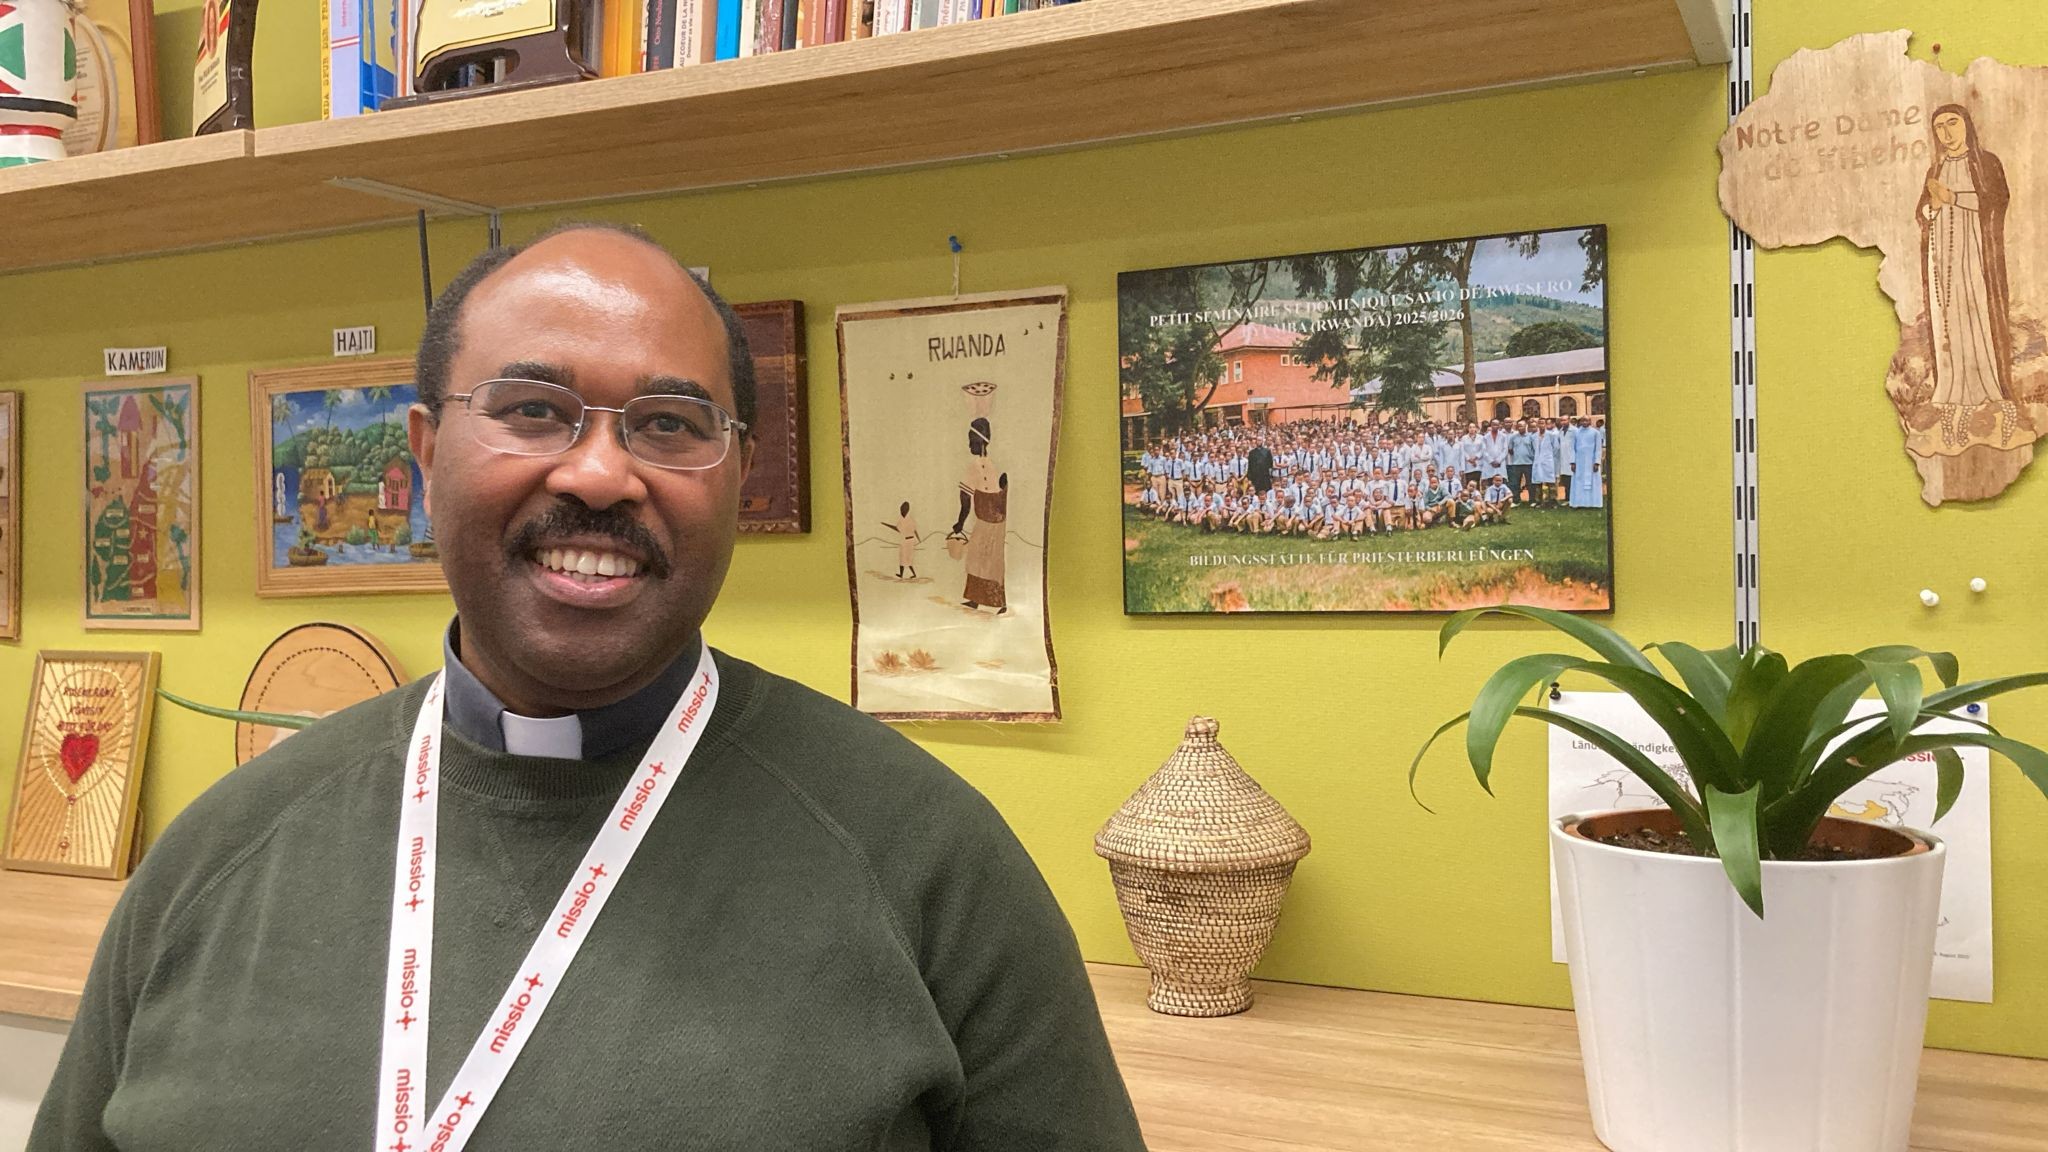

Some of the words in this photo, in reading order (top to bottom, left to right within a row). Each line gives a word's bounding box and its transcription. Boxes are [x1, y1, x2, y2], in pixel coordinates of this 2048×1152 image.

[681, 20, 688, 29] DE
[682, 8, 688, 18] LA
[679, 30, 687, 56] COEUR
[1736, 120, 1820, 151] Notre
[1836, 103, 1921, 135] Dame
[1150, 311, 1192, 327] PETIT
[1307, 294, 1401, 313] DOMINIQUE
[1405, 290, 1455, 304] SAVIO
[1460, 287, 1482, 301] DE
[1486, 279, 1573, 299] RWESERO
[1311, 314, 1392, 334] (RWANDA)
[1395, 308, 1465, 326] 2025/2026
[107, 349, 165, 371] KAMERUN
[337, 327, 374, 353] HAITI
[928, 332, 1006, 363] RWANDA
[1319, 551, 1348, 564] FÜR
[677, 686, 709, 733] missio
[416, 735, 432, 785] missio
[618, 776, 657, 831] missio
[408, 836, 425, 893] missio
[557, 879, 597, 938] missio
[400, 948, 419, 1009] missio
[489, 991, 531, 1055] missio
[394, 1068, 415, 1135] missio
[428, 1112, 462, 1152] ssio
